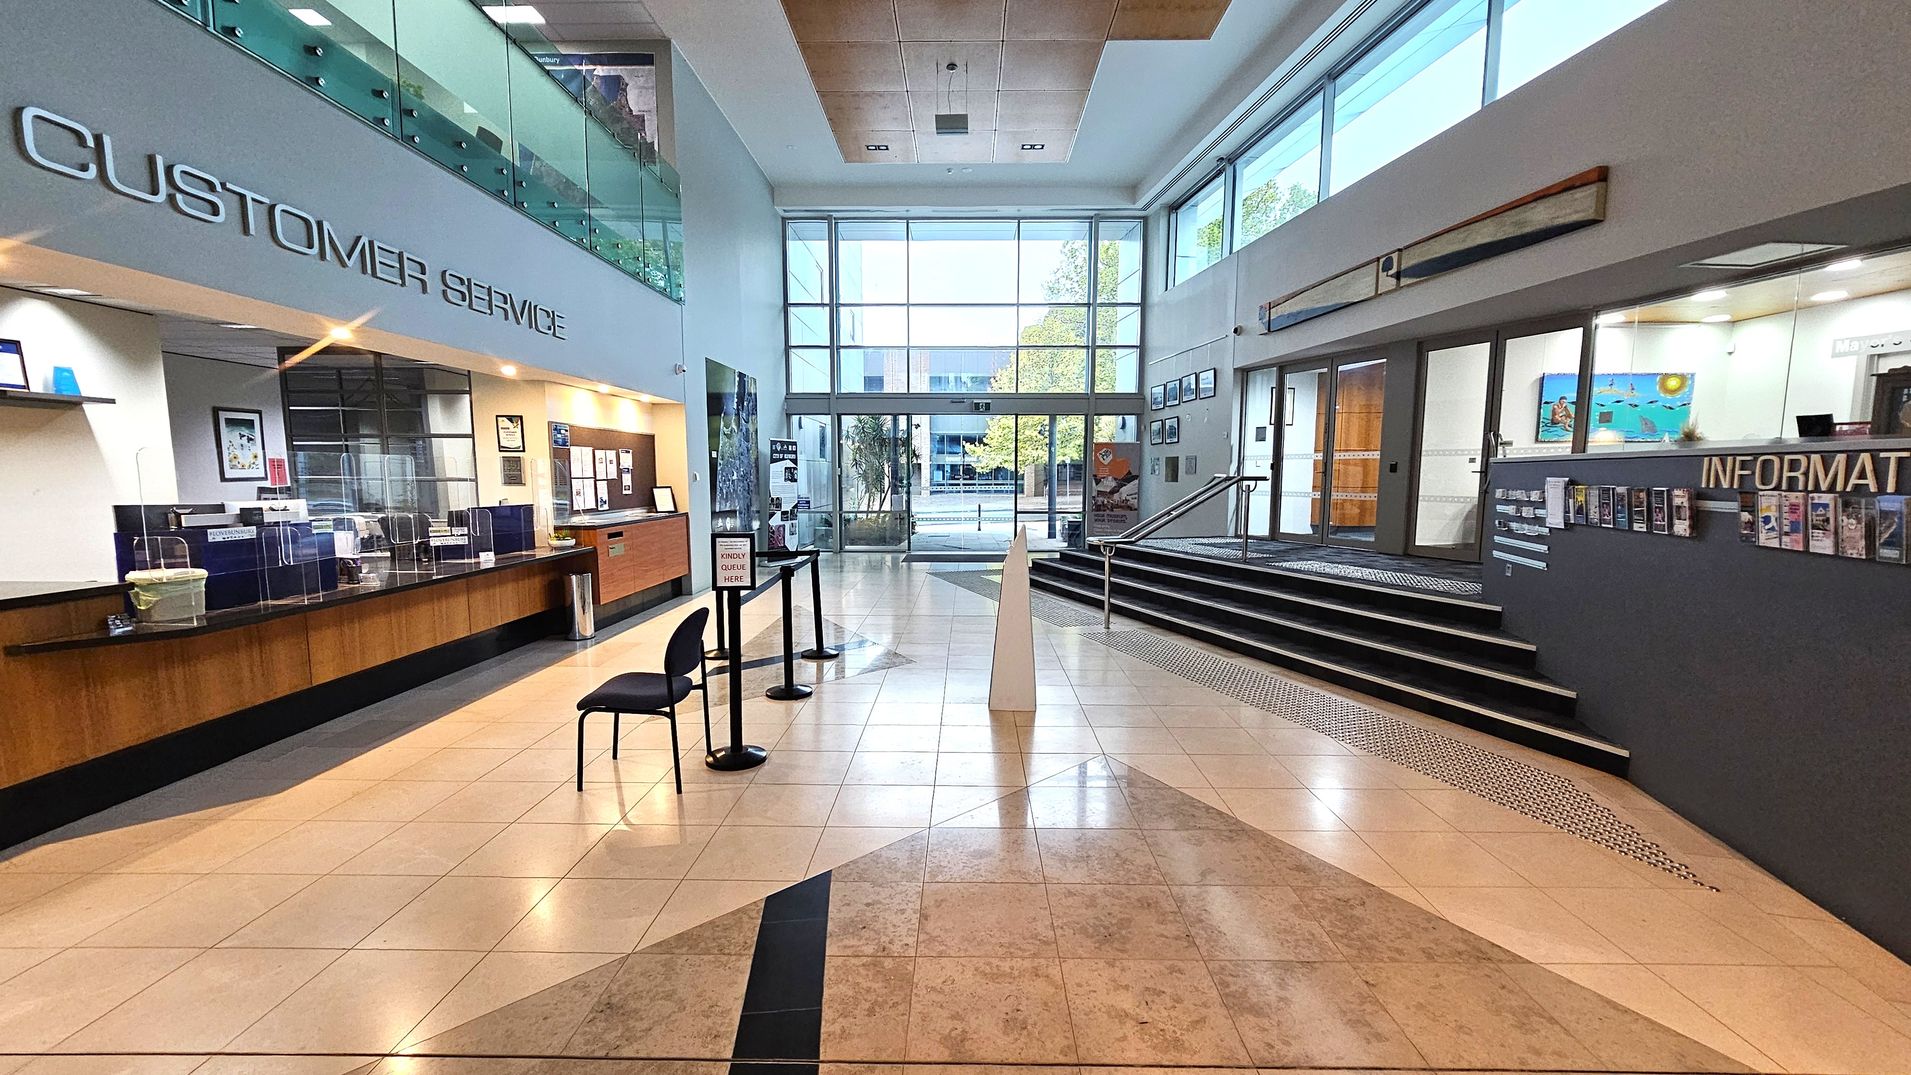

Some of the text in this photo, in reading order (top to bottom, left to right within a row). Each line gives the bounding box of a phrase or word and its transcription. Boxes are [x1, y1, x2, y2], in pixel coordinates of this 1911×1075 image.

[15, 106, 568, 341] CUSTOMER SERVICE
[1702, 453, 1911, 493] INFORMAT
[720, 552, 746, 560] KINDLY
[721, 563, 747, 571] QUEUE
